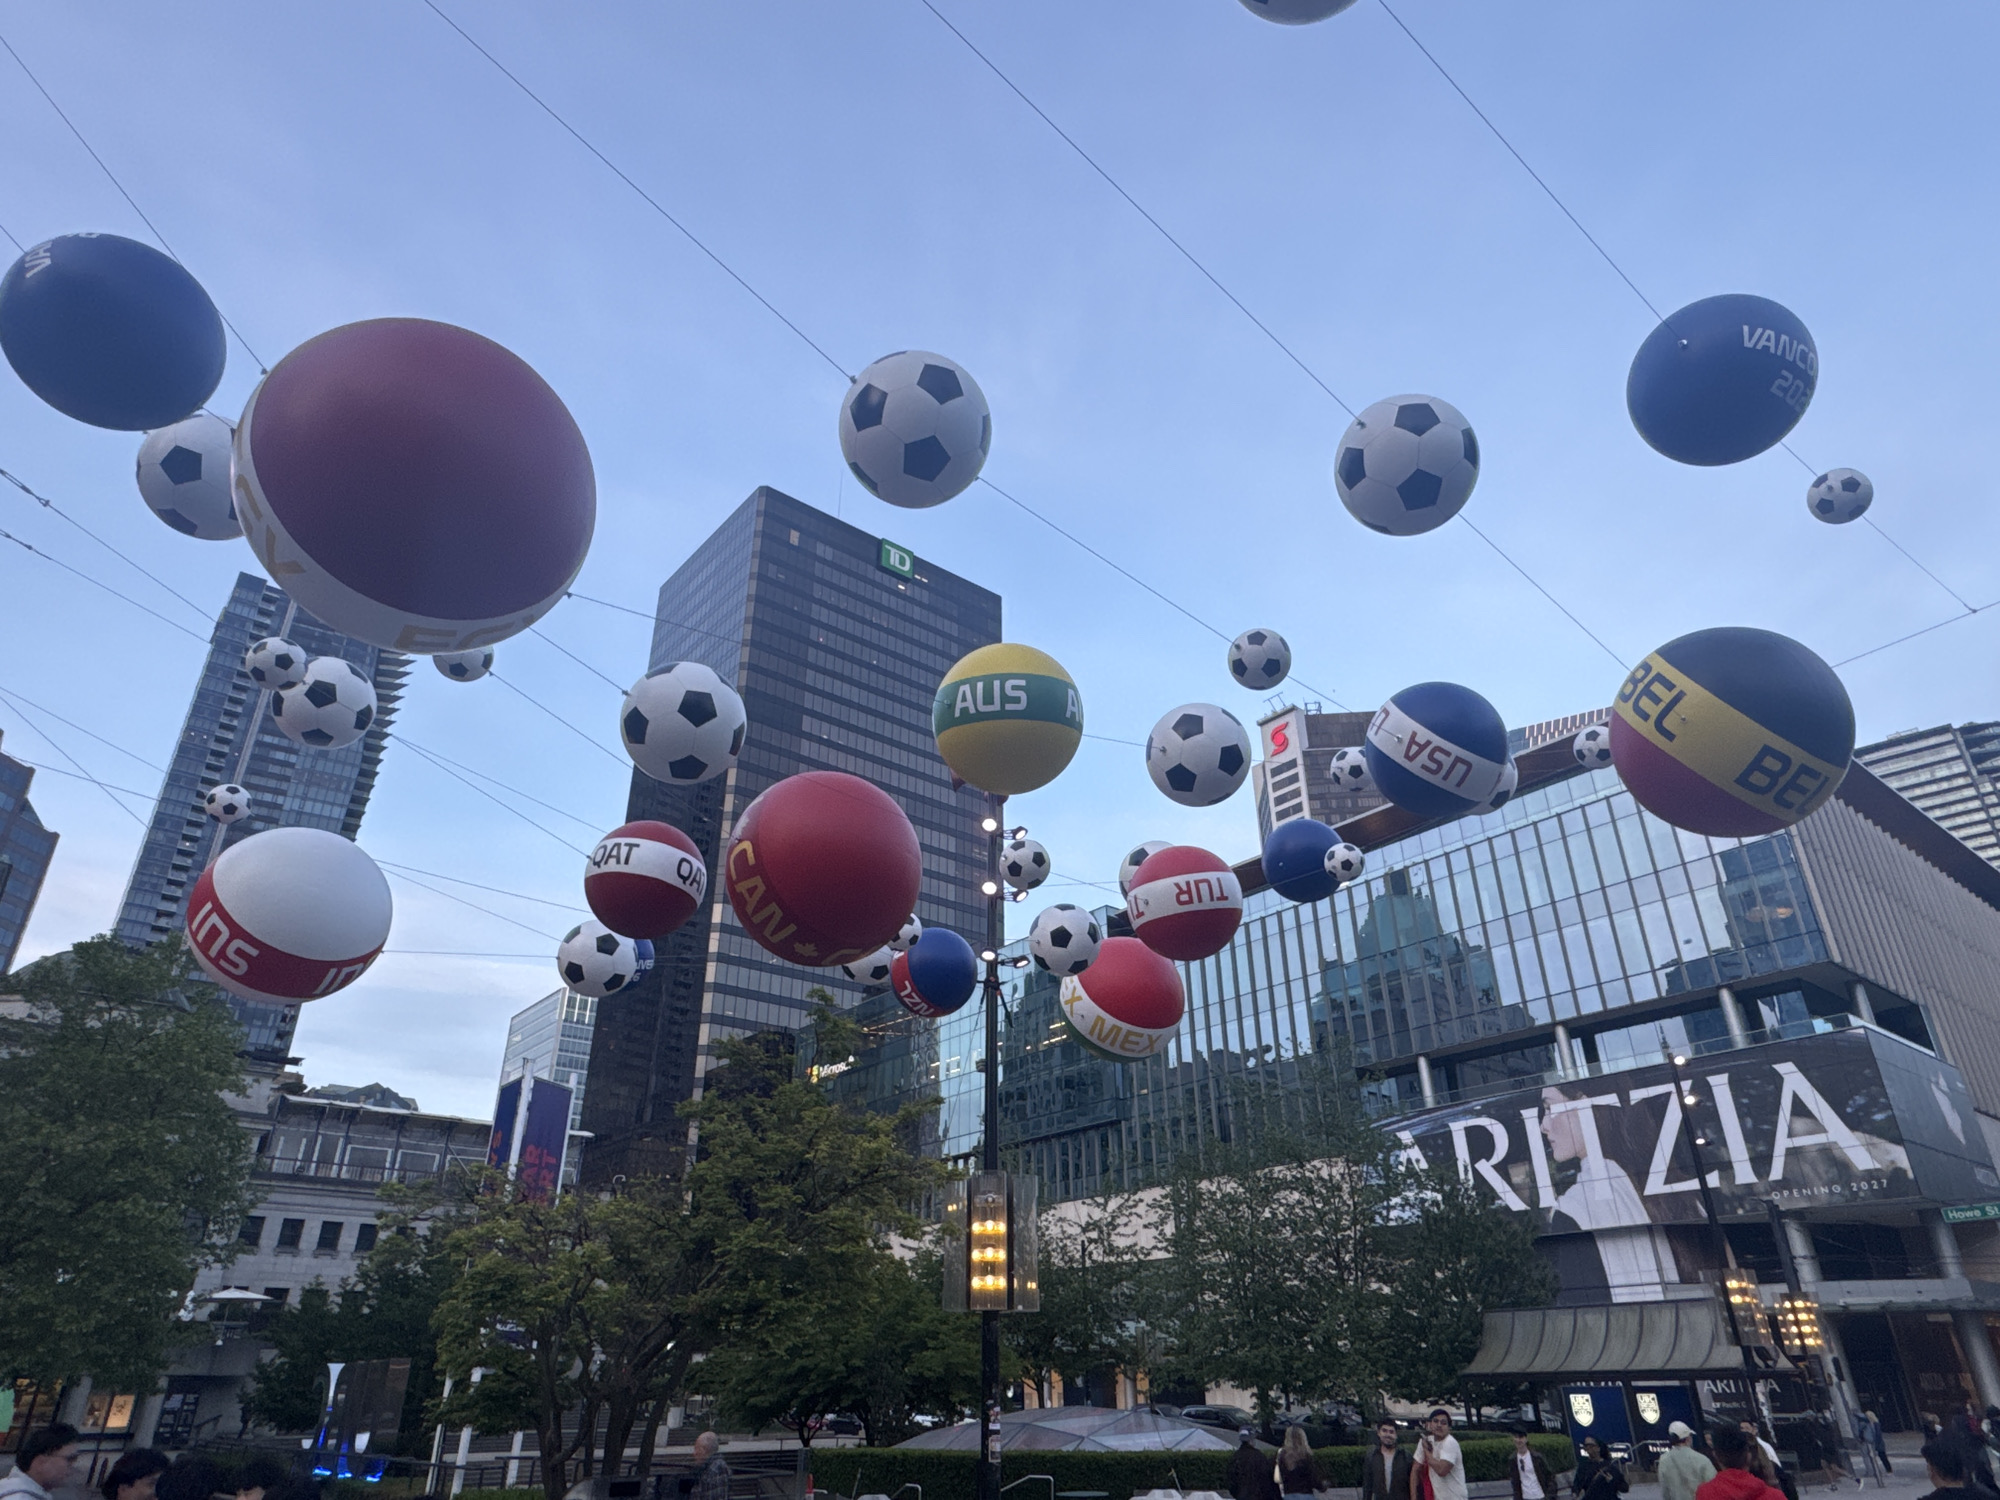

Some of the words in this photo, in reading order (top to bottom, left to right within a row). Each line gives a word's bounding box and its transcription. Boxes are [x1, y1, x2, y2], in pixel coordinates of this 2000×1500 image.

[885, 544, 911, 571] TD
[954, 679, 1028, 718] AUS
[1619, 661, 1687, 742] BEL
[1403, 730, 1473, 788] USA
[1734, 743, 1830, 815] BEL
[592, 842, 640, 869] QAT
[729, 840, 797, 943] CAN
[1174, 877, 1229, 906] TUR
[900, 980, 935, 1015] NZL
[1088, 1015, 1163, 1054] MEX
[1771, 1184, 1842, 1200] OPENING
[1850, 1179, 1888, 1192] 2027
[1947, 1209, 1982, 1219] Howe
[1985, 1205, 2000, 1216] St
